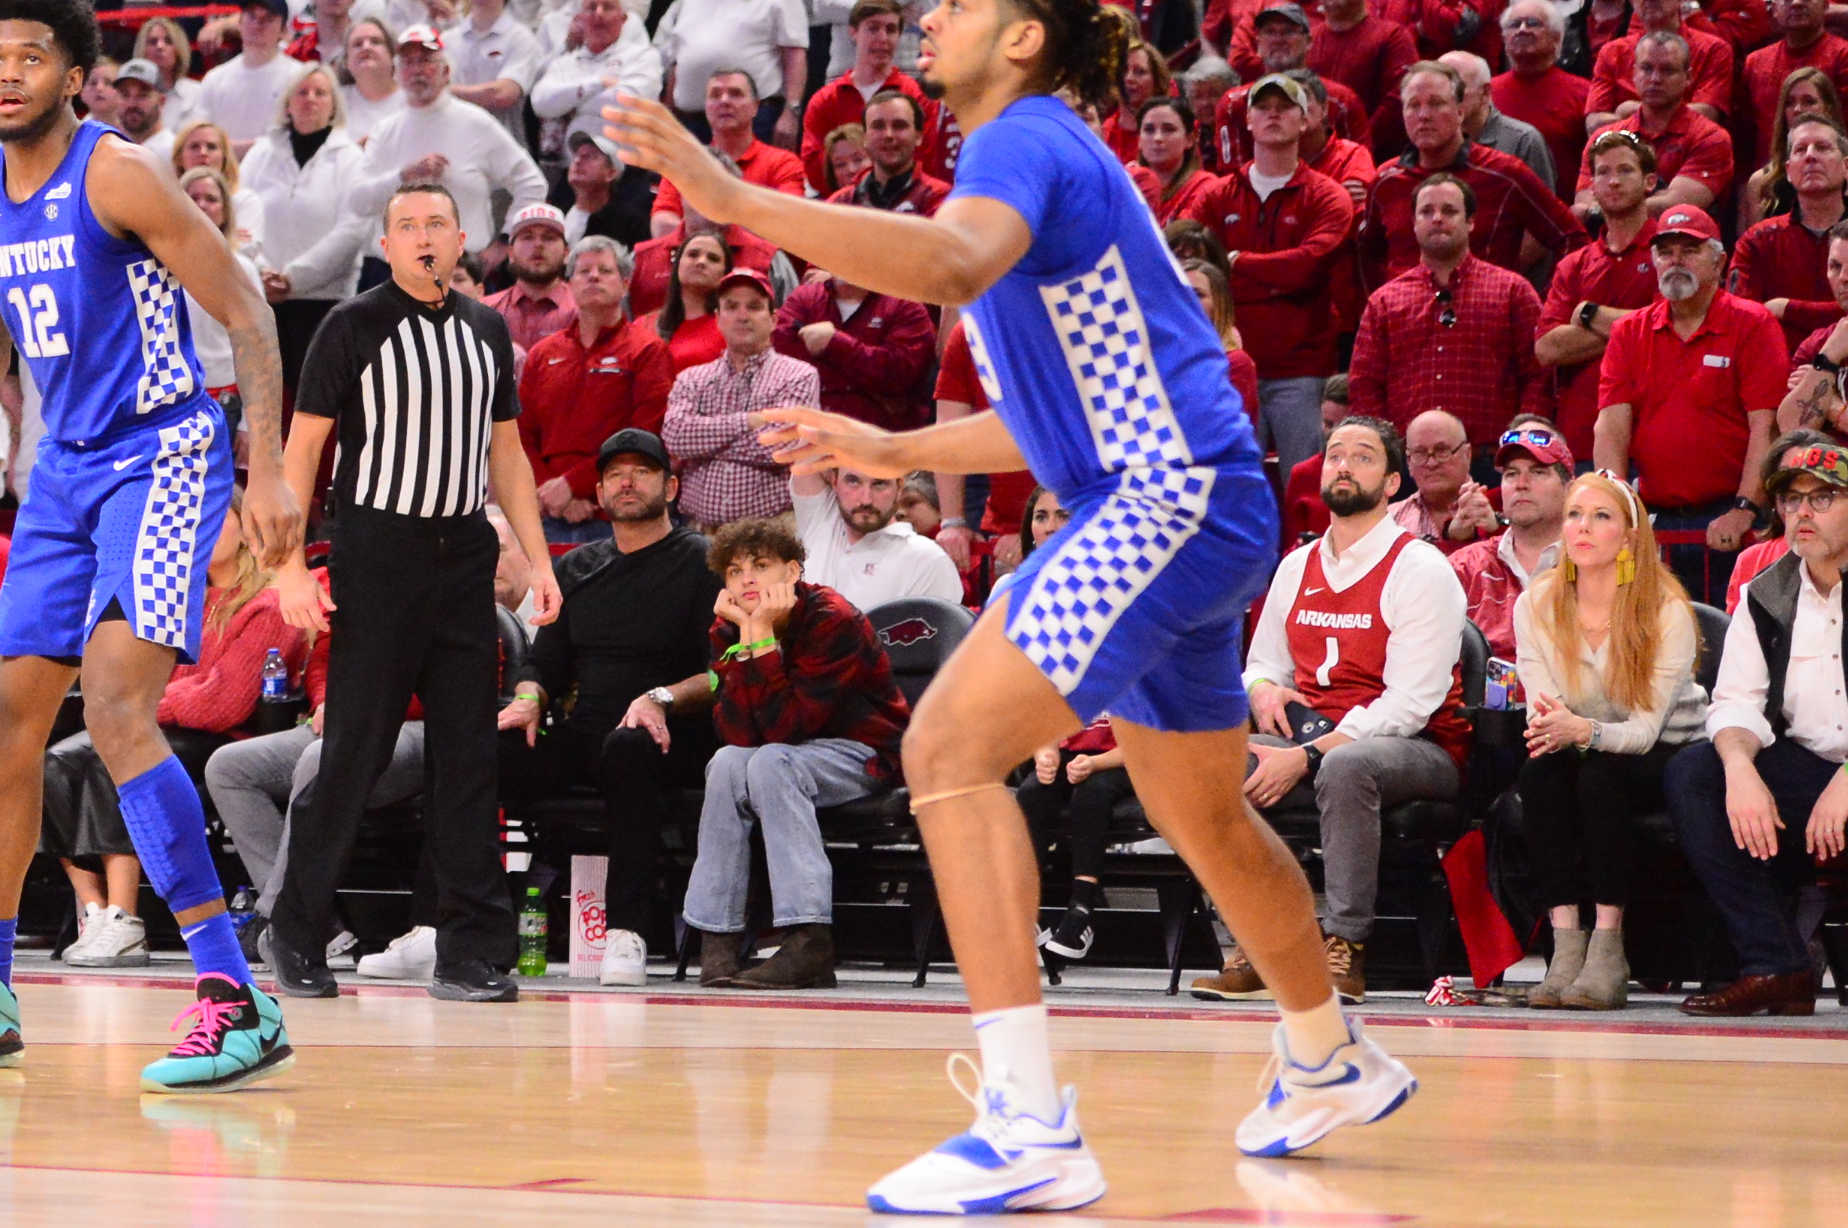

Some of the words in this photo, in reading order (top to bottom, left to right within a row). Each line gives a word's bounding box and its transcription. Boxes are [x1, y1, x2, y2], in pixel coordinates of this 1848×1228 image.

[7, 283, 70, 358] 12
[1296, 610, 1372, 629] ARKANSAS
[1316, 636, 1339, 687] 1
[585, 925, 606, 942] CO
